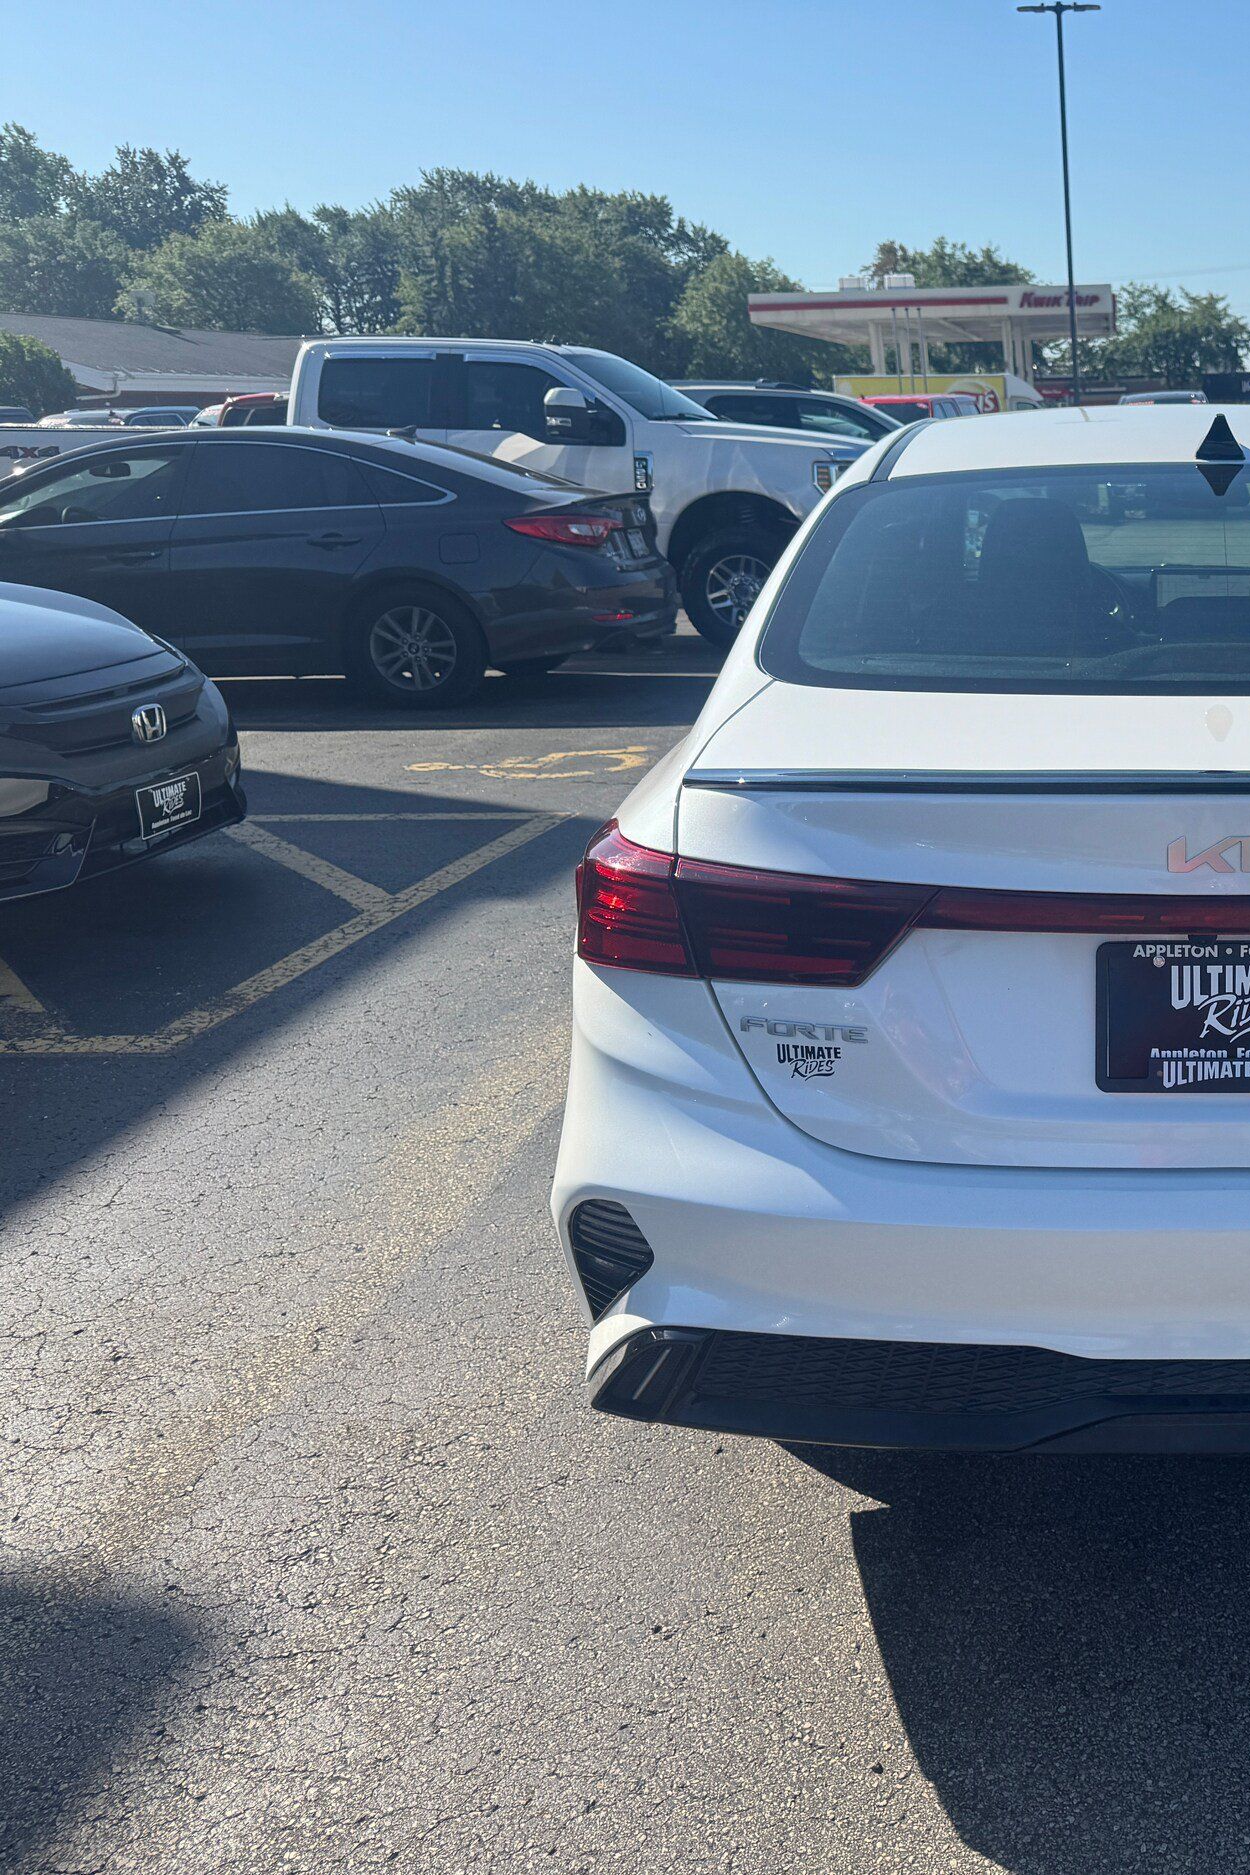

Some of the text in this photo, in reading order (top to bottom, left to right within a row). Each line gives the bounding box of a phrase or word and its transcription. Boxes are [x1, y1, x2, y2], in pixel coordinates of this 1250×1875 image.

[152, 781, 187, 807] ULTIMATE
[1133, 945, 1219, 959] APPLETON
[740, 1015, 869, 1044] FORTE
[776, 1043, 842, 1064] ULTIMATE
